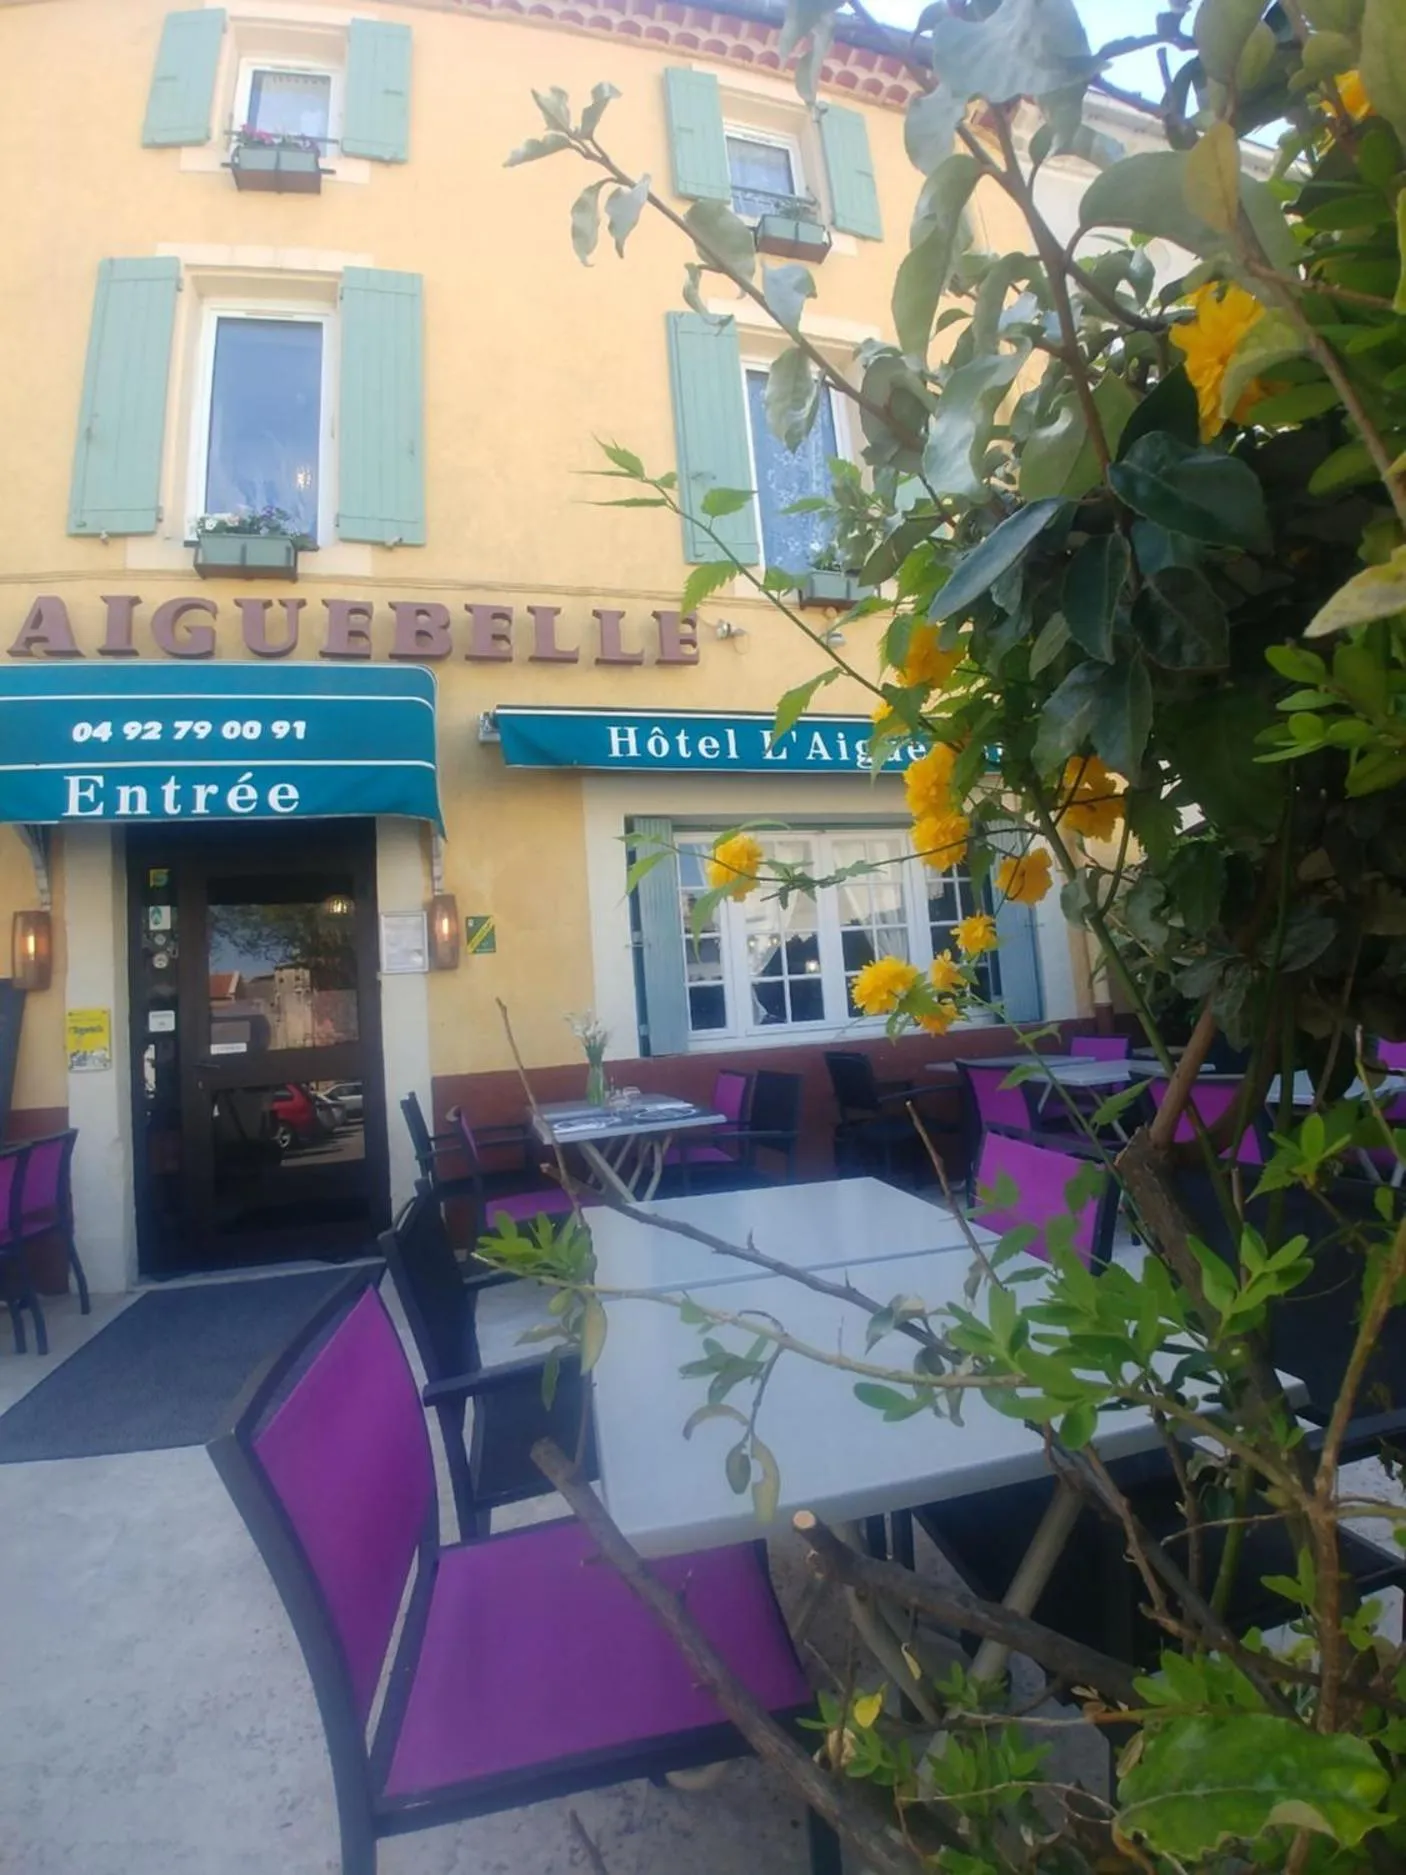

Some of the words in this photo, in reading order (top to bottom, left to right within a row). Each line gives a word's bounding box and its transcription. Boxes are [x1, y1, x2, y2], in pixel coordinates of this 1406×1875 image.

[7, 595, 700, 666] AIGUEBELLE
[72, 721, 113, 742] 04
[122, 721, 163, 740] 92
[173, 720, 212, 740] 79
[222, 720, 262, 740] 00
[271, 720, 307, 740] 91
[607, 726, 740, 759] Hôtel
[61, 771, 300, 817] Entrée
